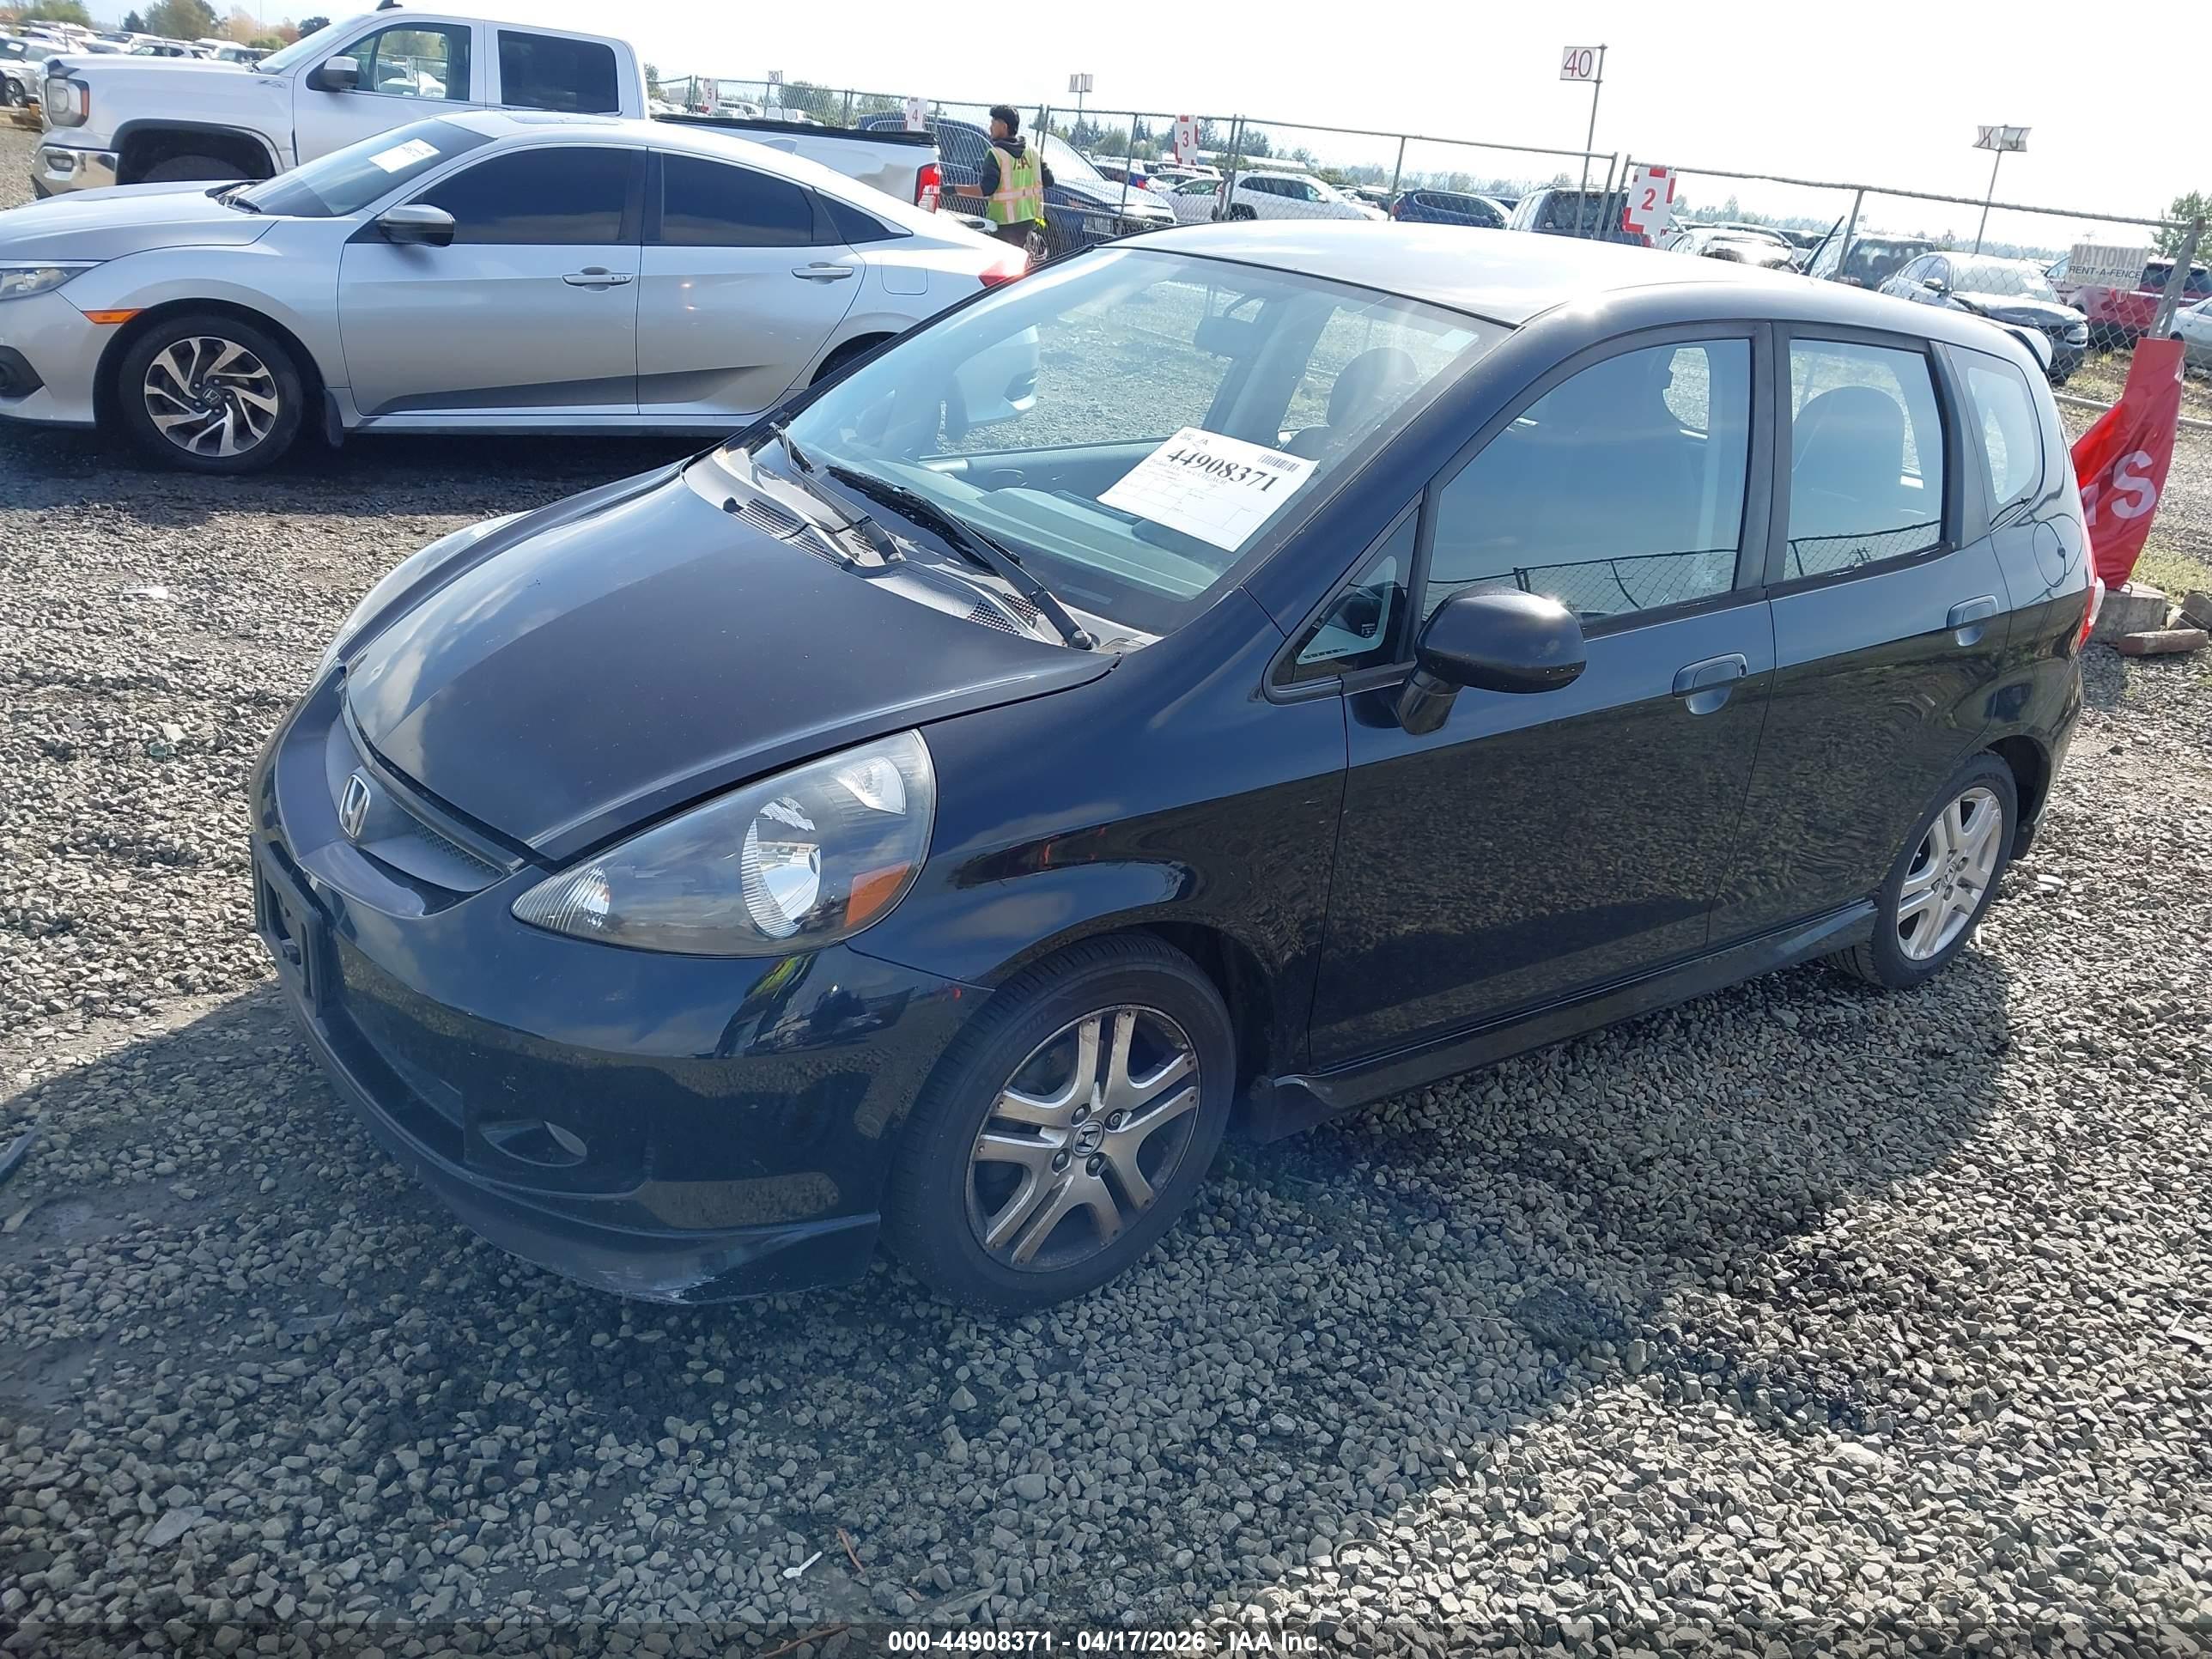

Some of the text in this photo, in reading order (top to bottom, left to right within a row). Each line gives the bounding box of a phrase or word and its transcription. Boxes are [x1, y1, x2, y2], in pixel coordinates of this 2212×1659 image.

[1564, 49, 1593, 78] 40
[769, 71, 780, 82] 30
[707, 88, 713, 100] 5
[912, 109, 919, 122] 4
[1182, 130, 1189, 148] 3
[2009, 128, 2024, 149] J
[1641, 188, 1656, 211] 2
[2071, 245, 2145, 270] NATIONAL
[2068, 265, 2142, 279] RENT-A-FENCE
[1167, 448, 1279, 493] 44908371
